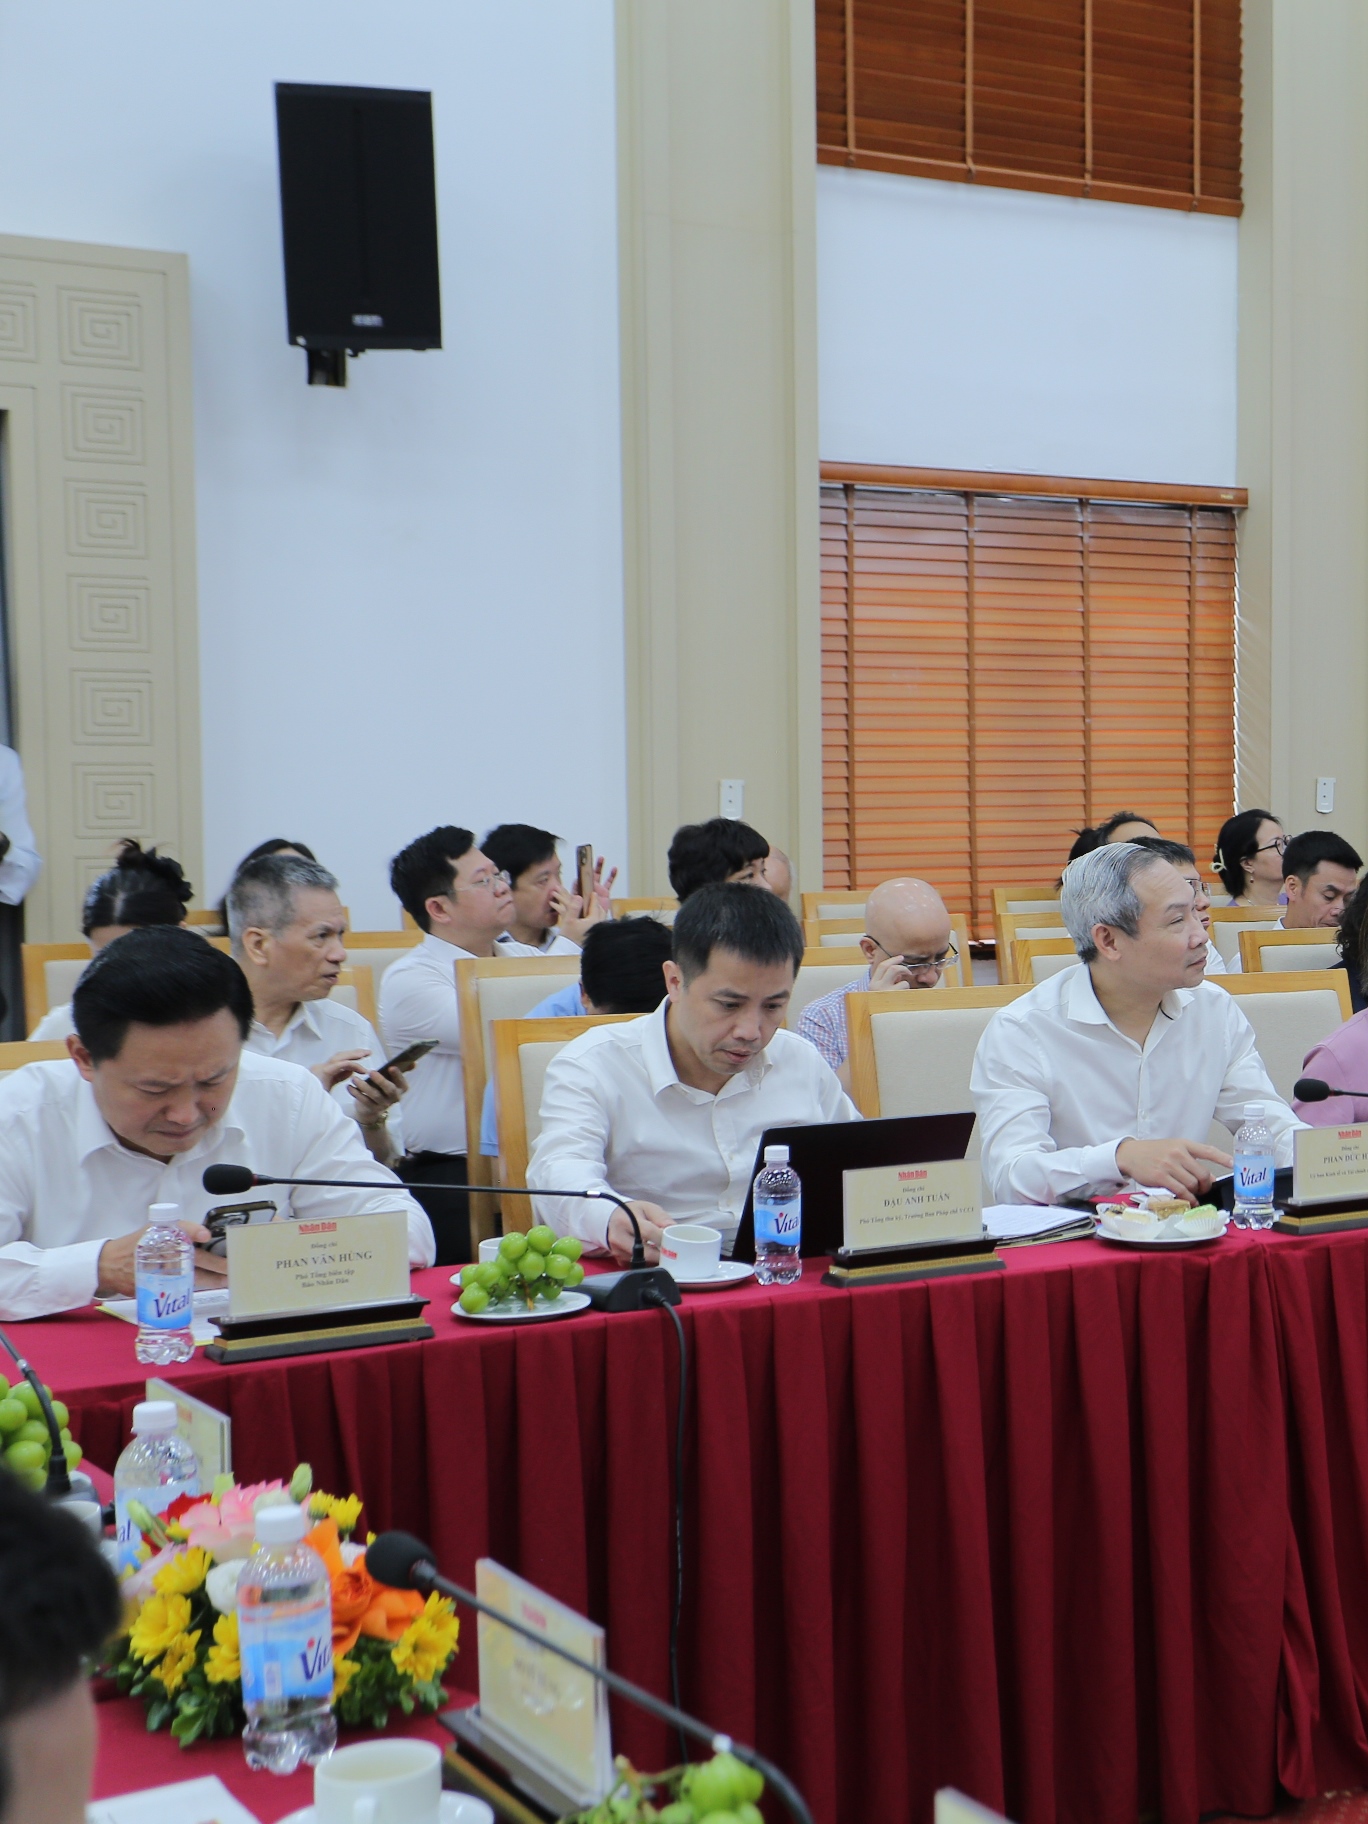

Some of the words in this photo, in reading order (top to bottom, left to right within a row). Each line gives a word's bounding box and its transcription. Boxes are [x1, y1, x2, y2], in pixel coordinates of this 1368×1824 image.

[1240, 1167, 1267, 1187] Vital
[905, 1196, 924, 1206] ANH
[298, 1223, 320, 1234] Nhân
[321, 1222, 337, 1232] Dân
[276, 1256, 309, 1269] PHAN
[311, 1252, 336, 1265] VĂN
[339, 1250, 373, 1263] HÙNG
[154, 1288, 191, 1318] Vital
